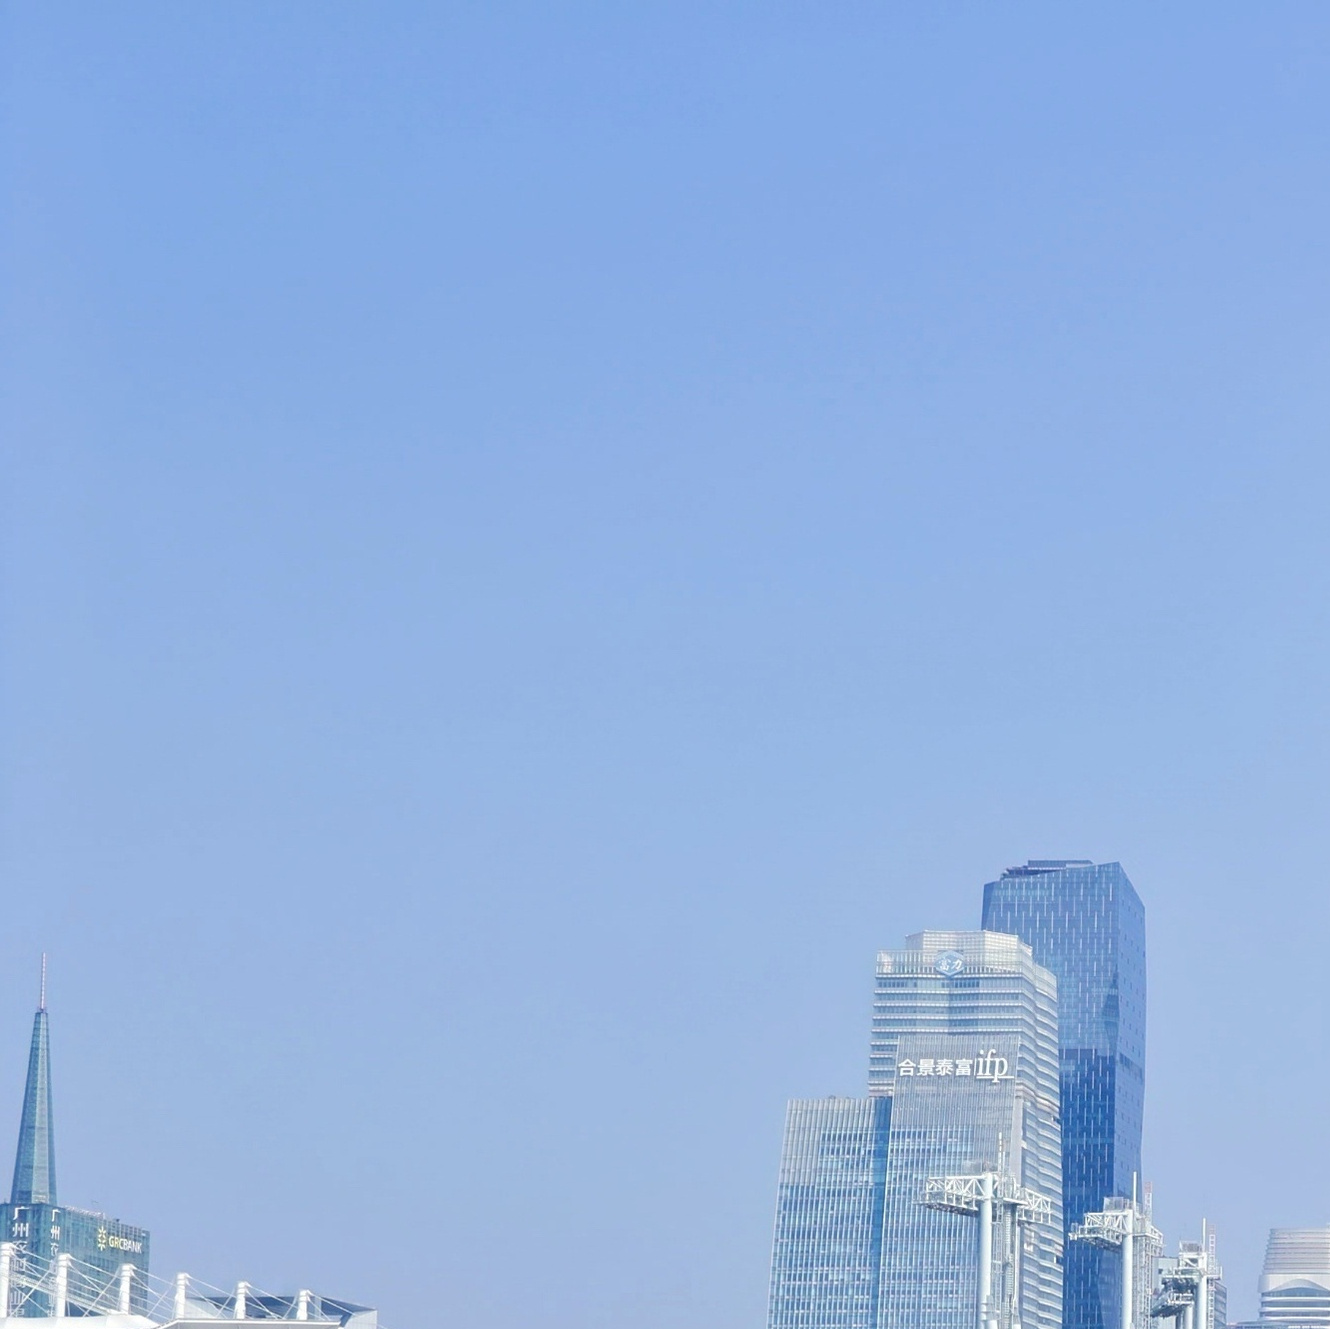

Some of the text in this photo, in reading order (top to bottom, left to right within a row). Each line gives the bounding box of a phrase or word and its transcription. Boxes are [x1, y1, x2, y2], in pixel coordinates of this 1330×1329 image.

[898, 1058, 973, 1077] 合景泰富
[108, 1235, 142, 1254] GRCBANK
